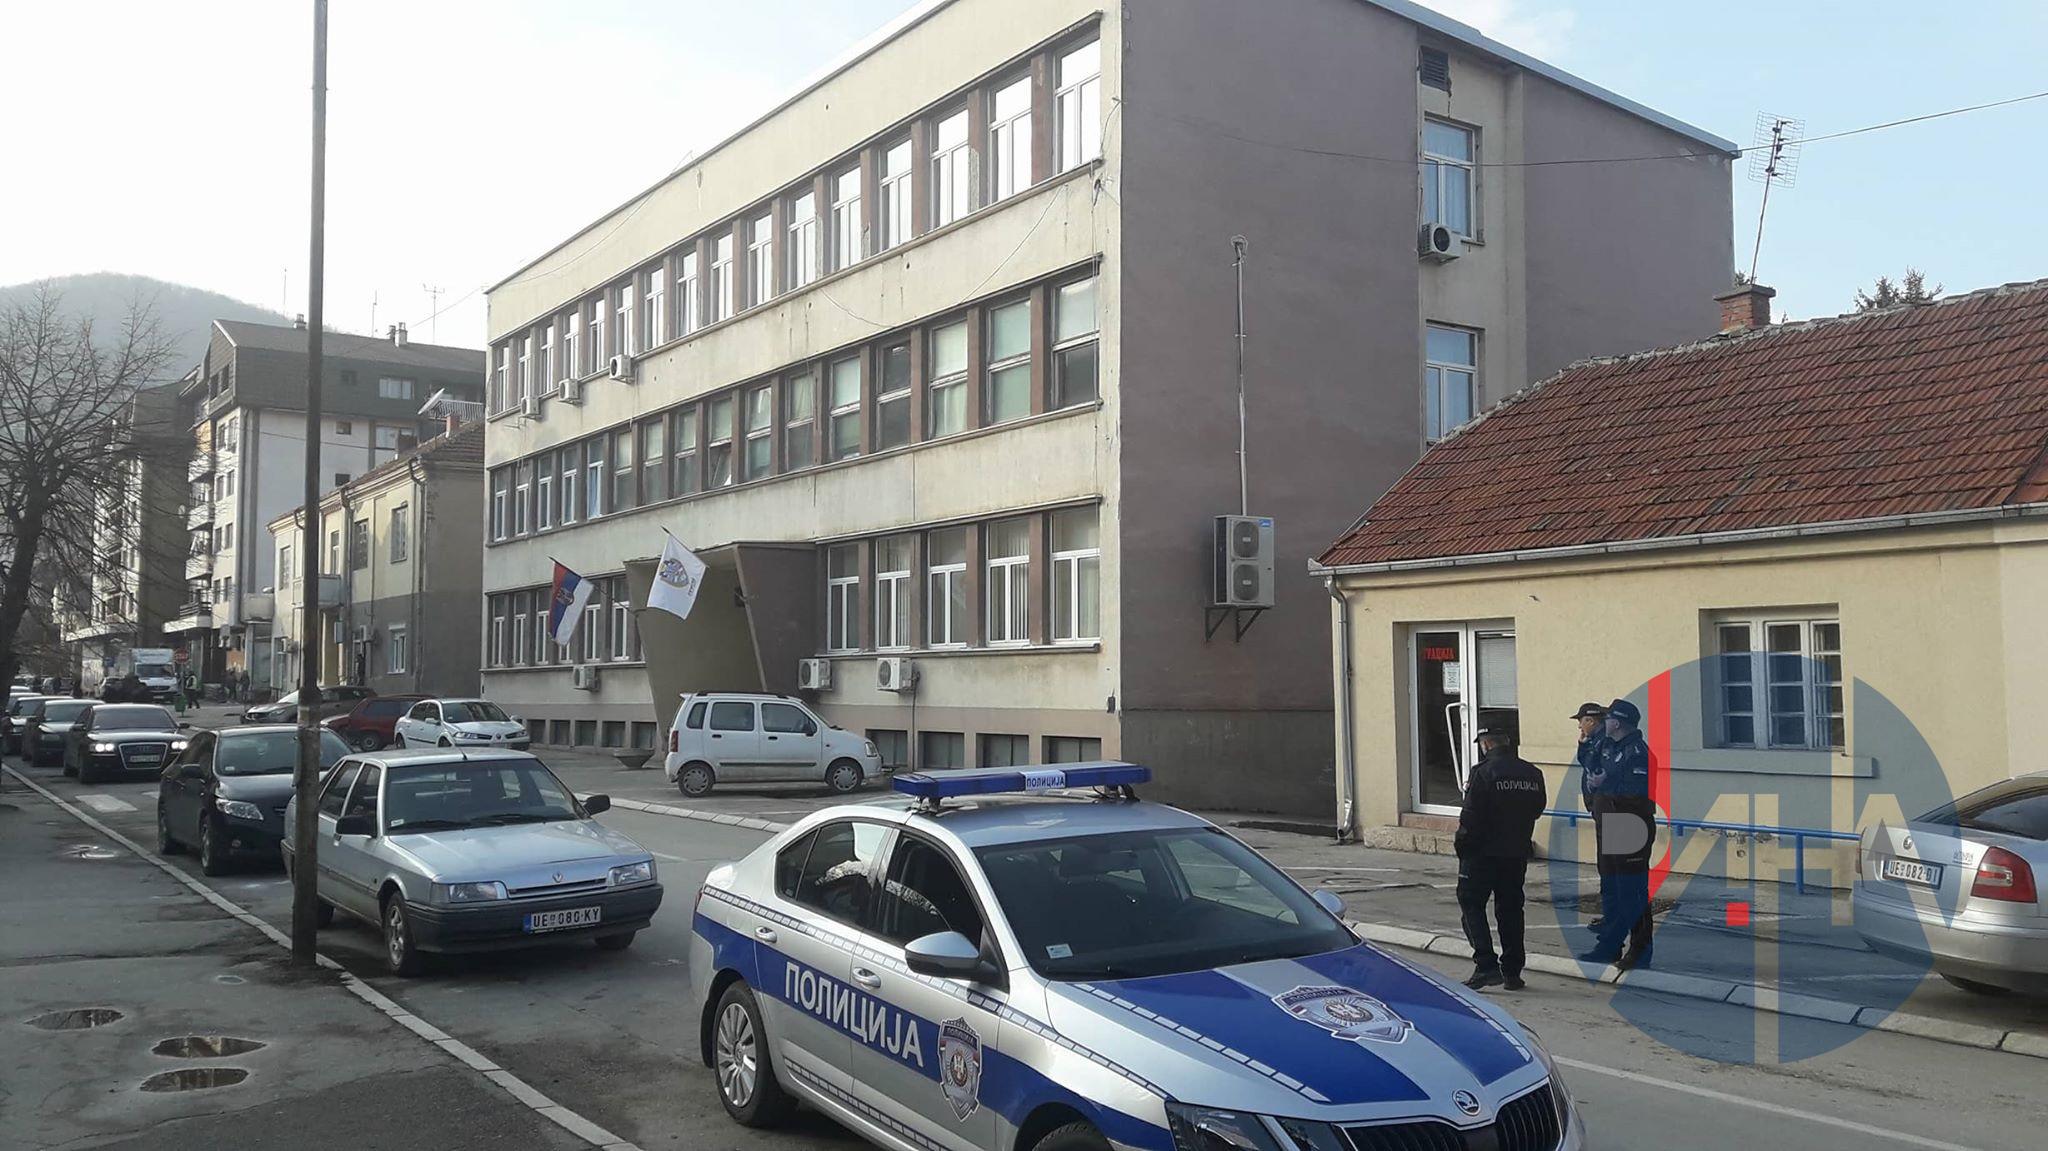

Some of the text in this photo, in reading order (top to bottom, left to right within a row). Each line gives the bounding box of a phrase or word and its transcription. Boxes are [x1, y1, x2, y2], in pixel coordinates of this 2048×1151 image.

[1026, 776, 1065, 788] ПОЛИЦИЈА
[533, 914, 548, 927] UE
[785, 961, 924, 1068] ПОЛИЦИЈА
